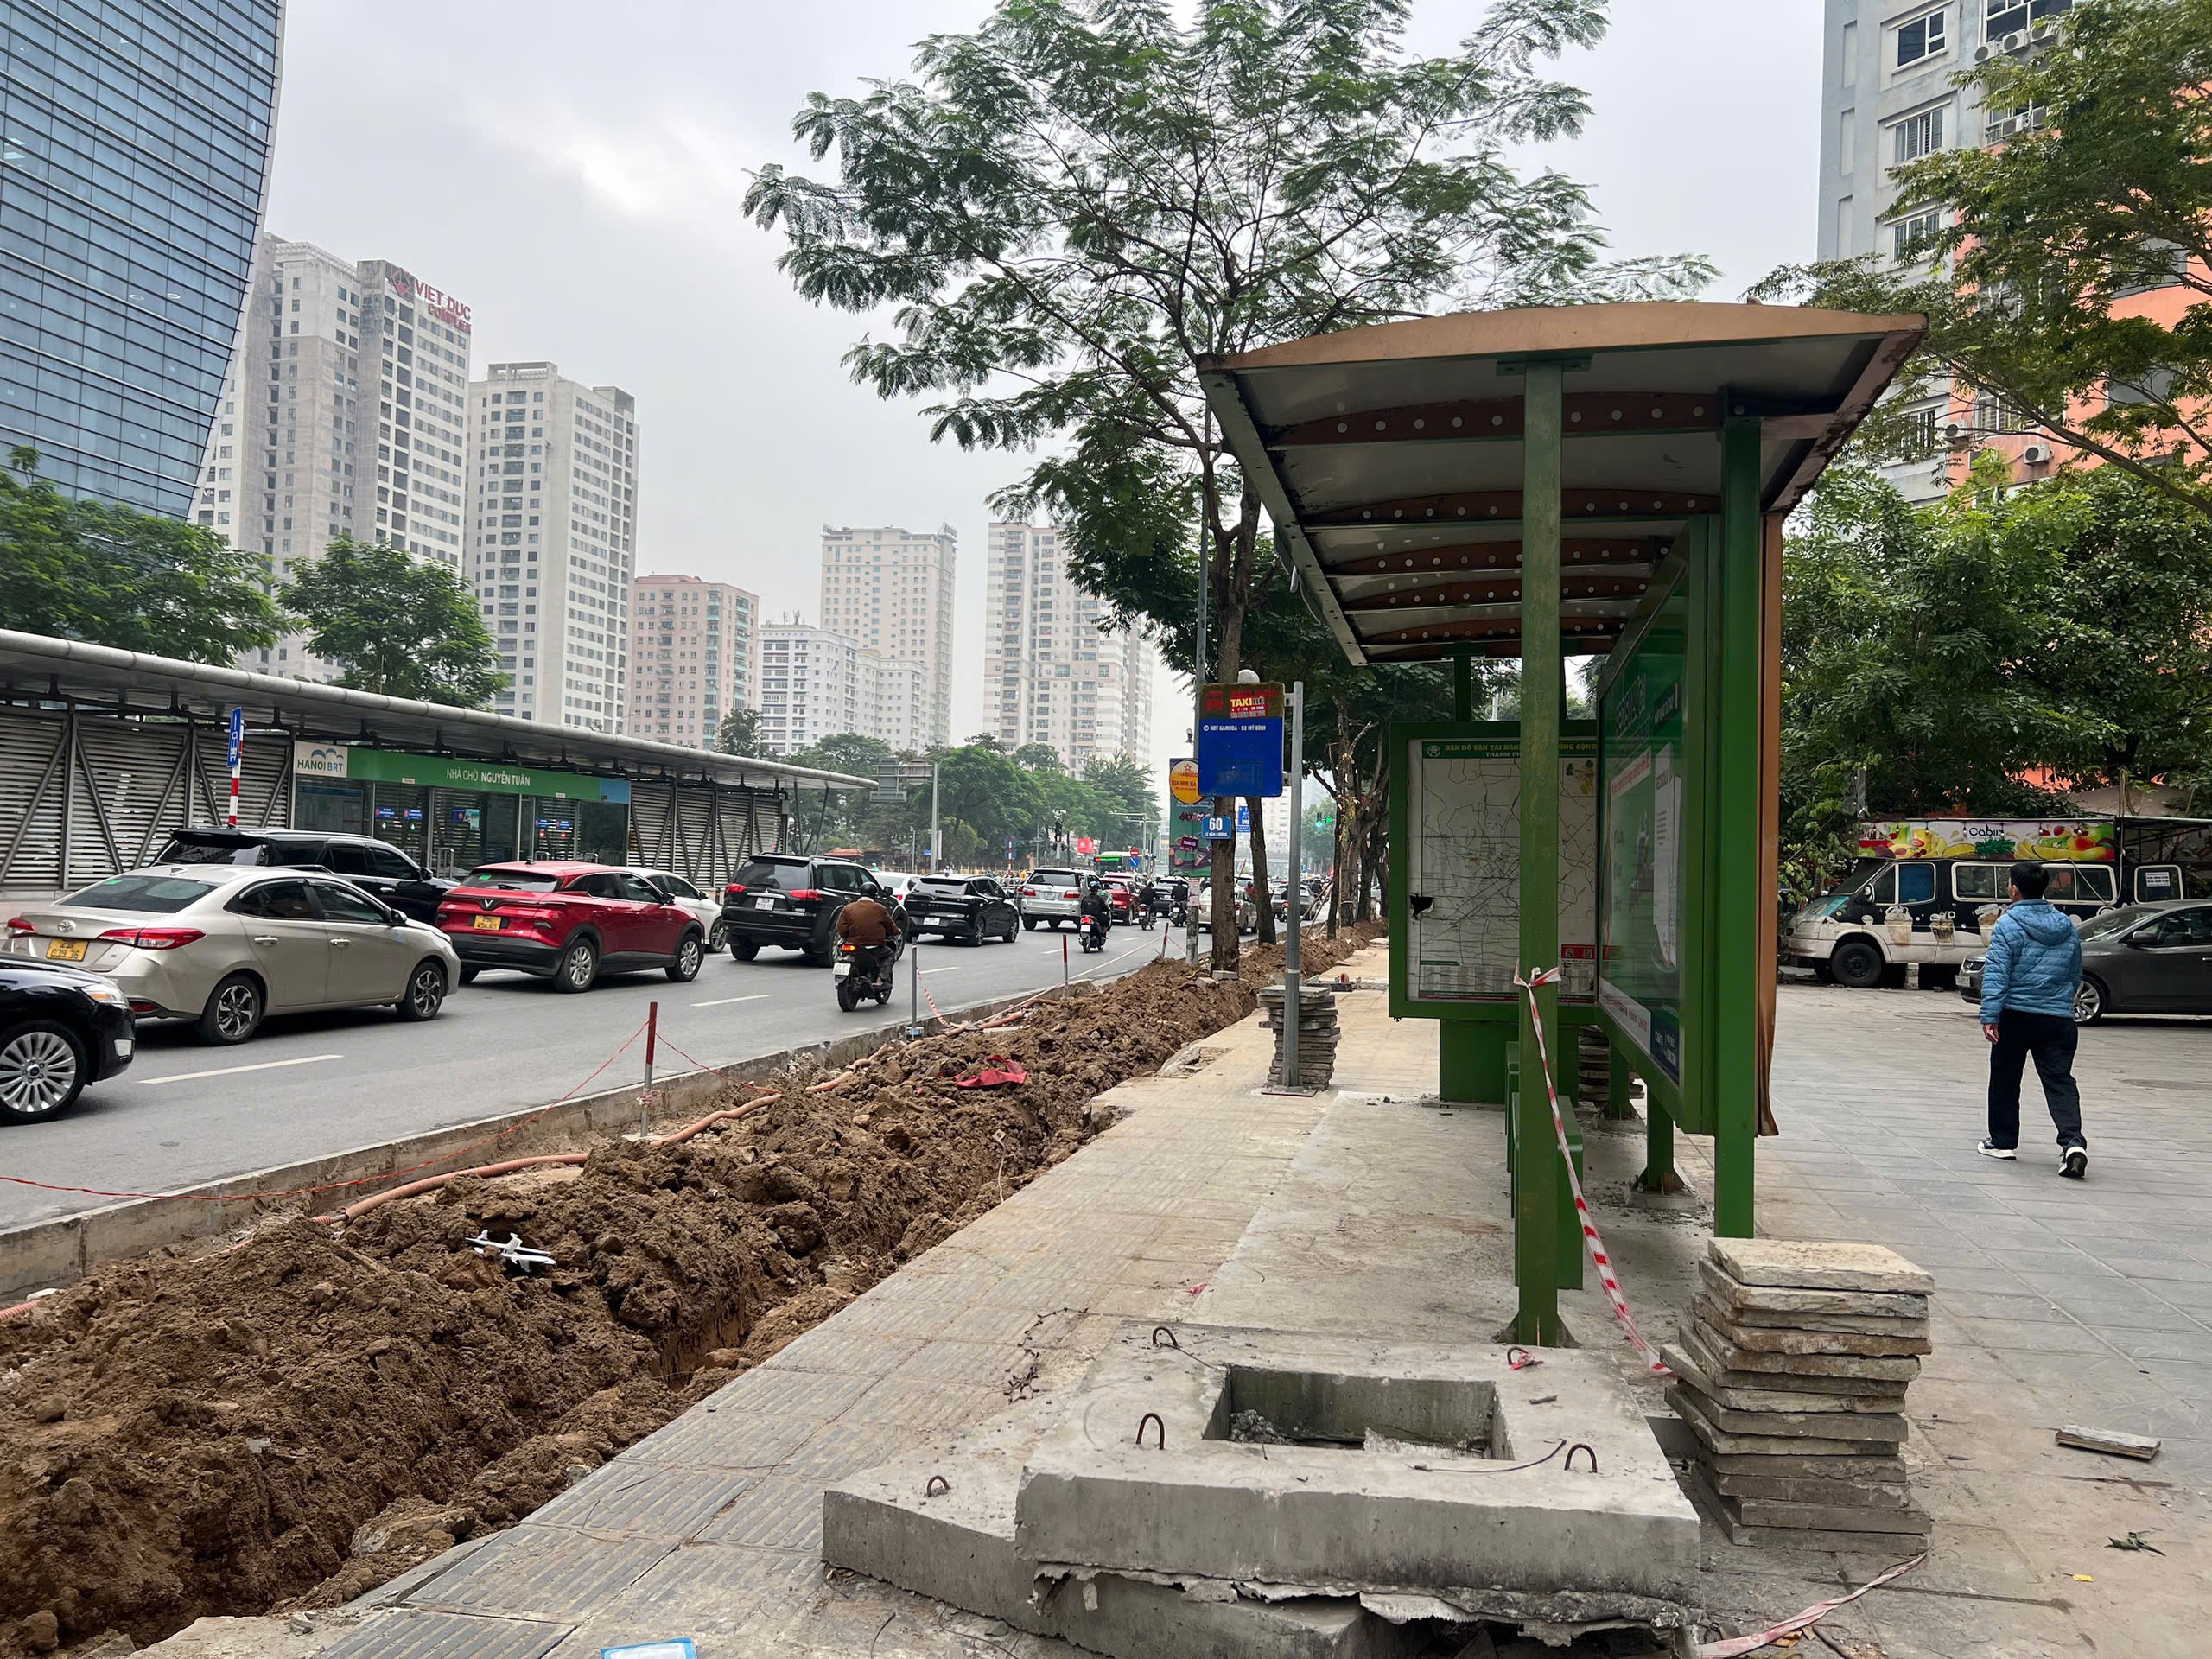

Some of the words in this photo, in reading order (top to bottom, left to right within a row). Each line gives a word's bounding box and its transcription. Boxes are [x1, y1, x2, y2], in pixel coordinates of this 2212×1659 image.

[416, 279, 444, 305] VIET
[448, 296, 472, 321] DUC
[428, 304, 471, 333] COMPLEX
[1230, 697, 1252, 707] TAXI
[297, 758, 326, 771] HANOI
[327, 761, 344, 772] BRT
[446, 766, 461, 779] NHÀ
[463, 767, 479, 782] CHỜ
[481, 770, 511, 785] NGUYỄN
[512, 773, 531, 786] TUÂN
[1209, 817, 1223, 831] 60
